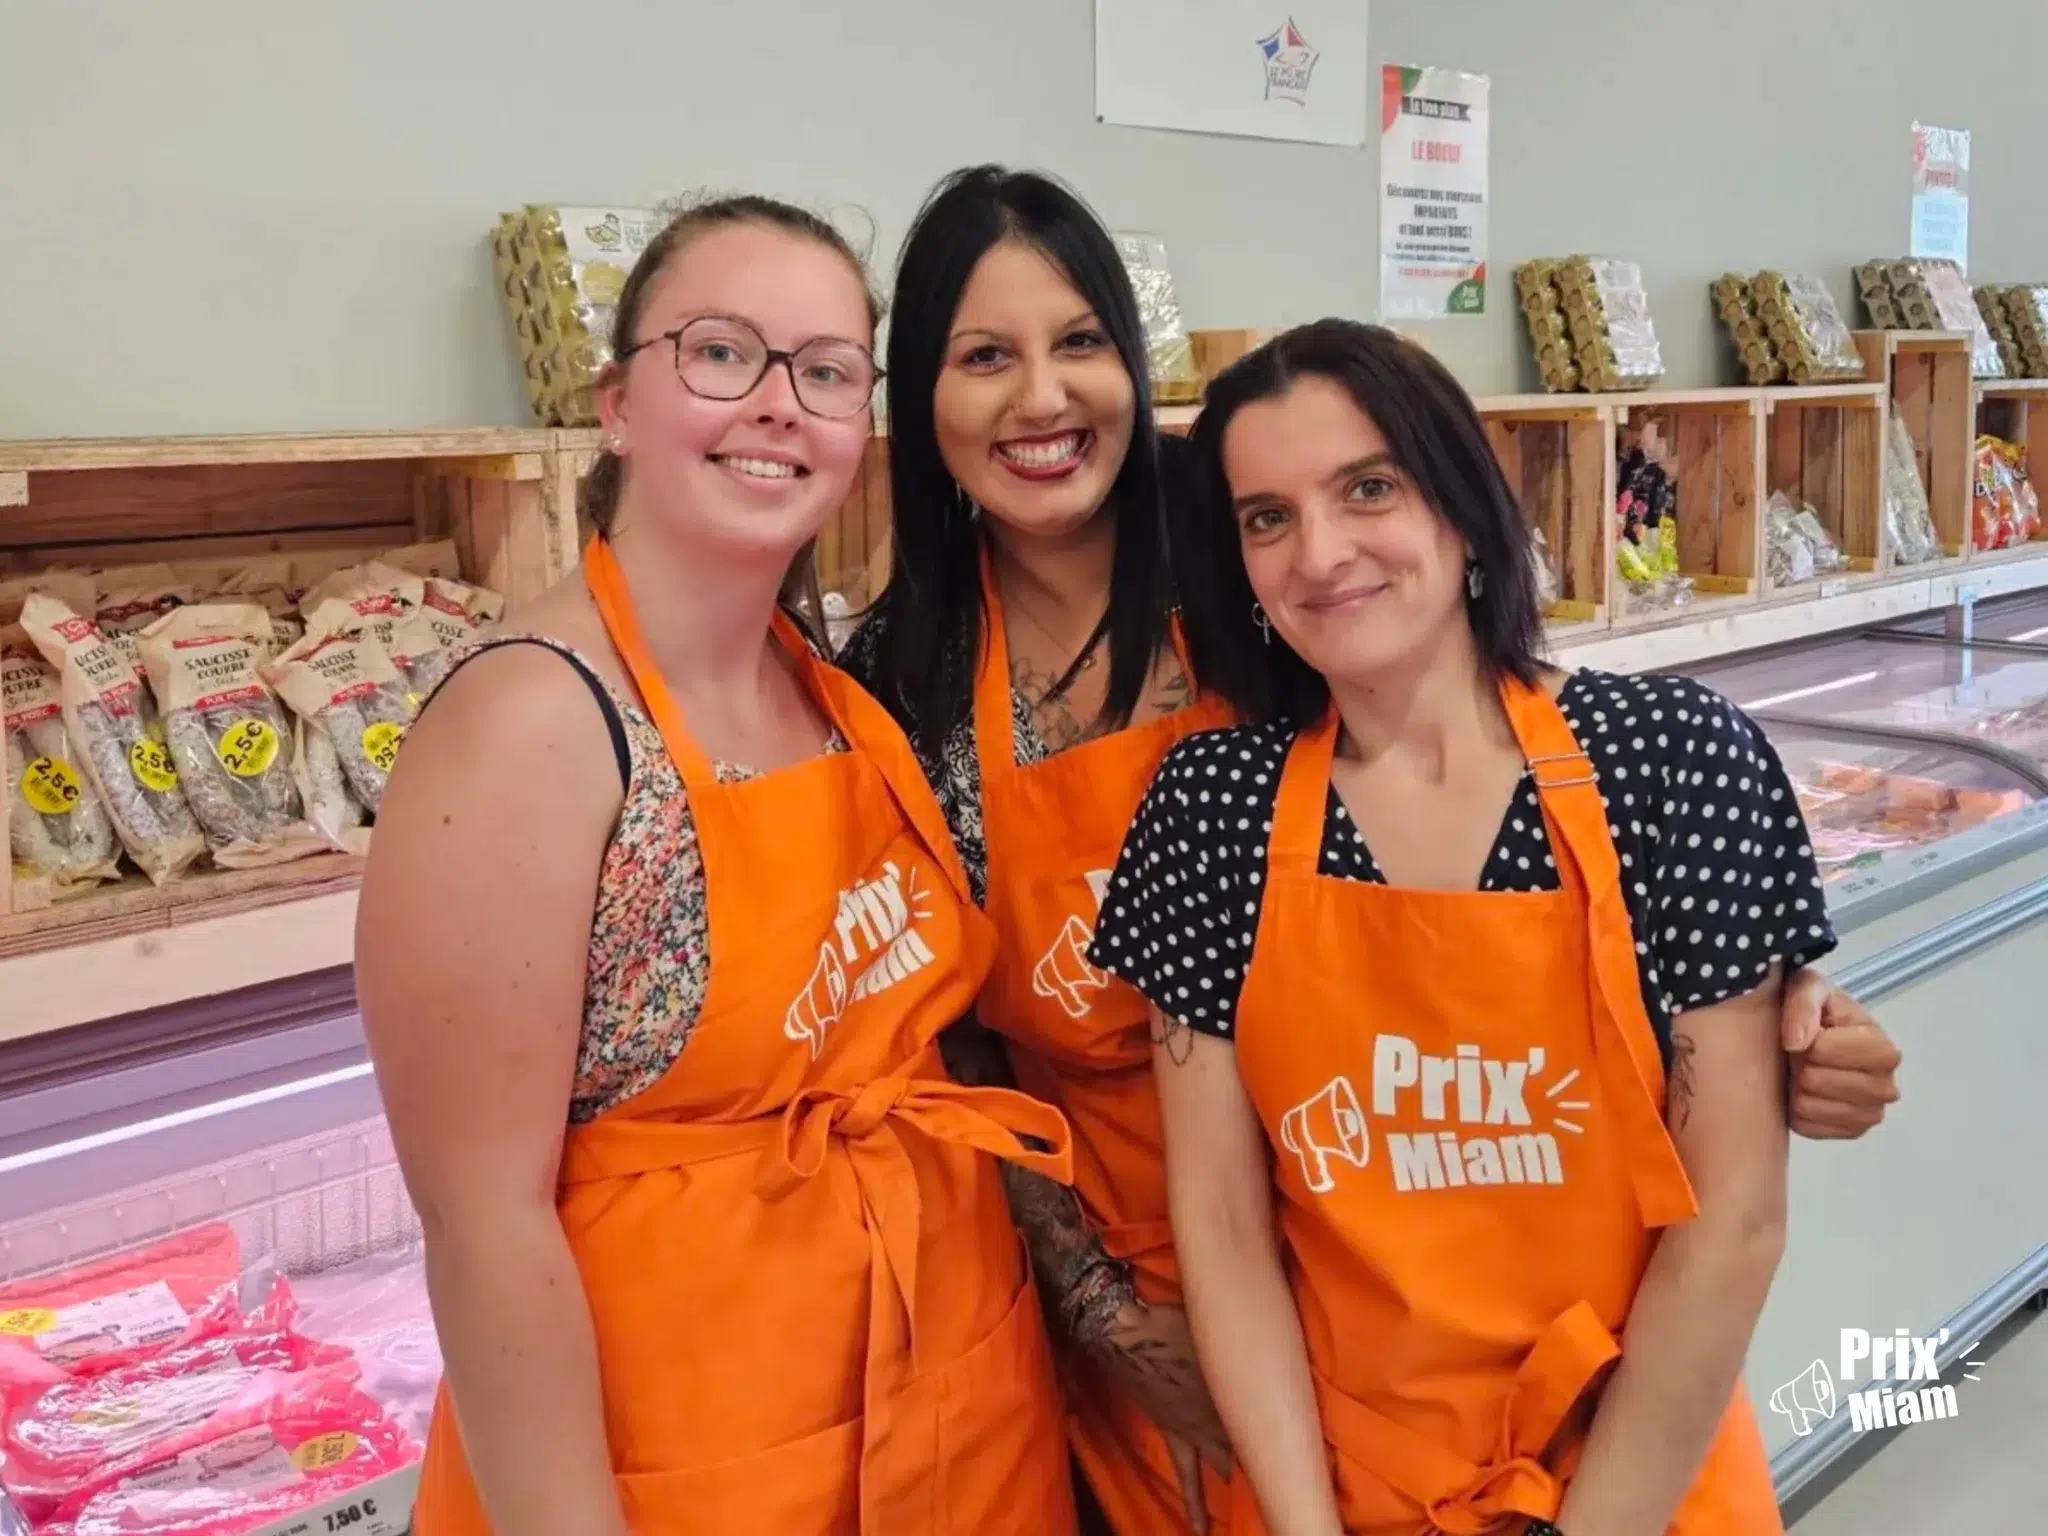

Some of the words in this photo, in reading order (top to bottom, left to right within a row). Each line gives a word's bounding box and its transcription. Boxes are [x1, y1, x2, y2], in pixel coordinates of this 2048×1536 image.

[1411, 140, 1424, 160] LE
[184, 649, 251, 671] SAUCISSE
[1373, 1033, 1546, 1126] Prix'
[1386, 1131, 1564, 1193] Miam
